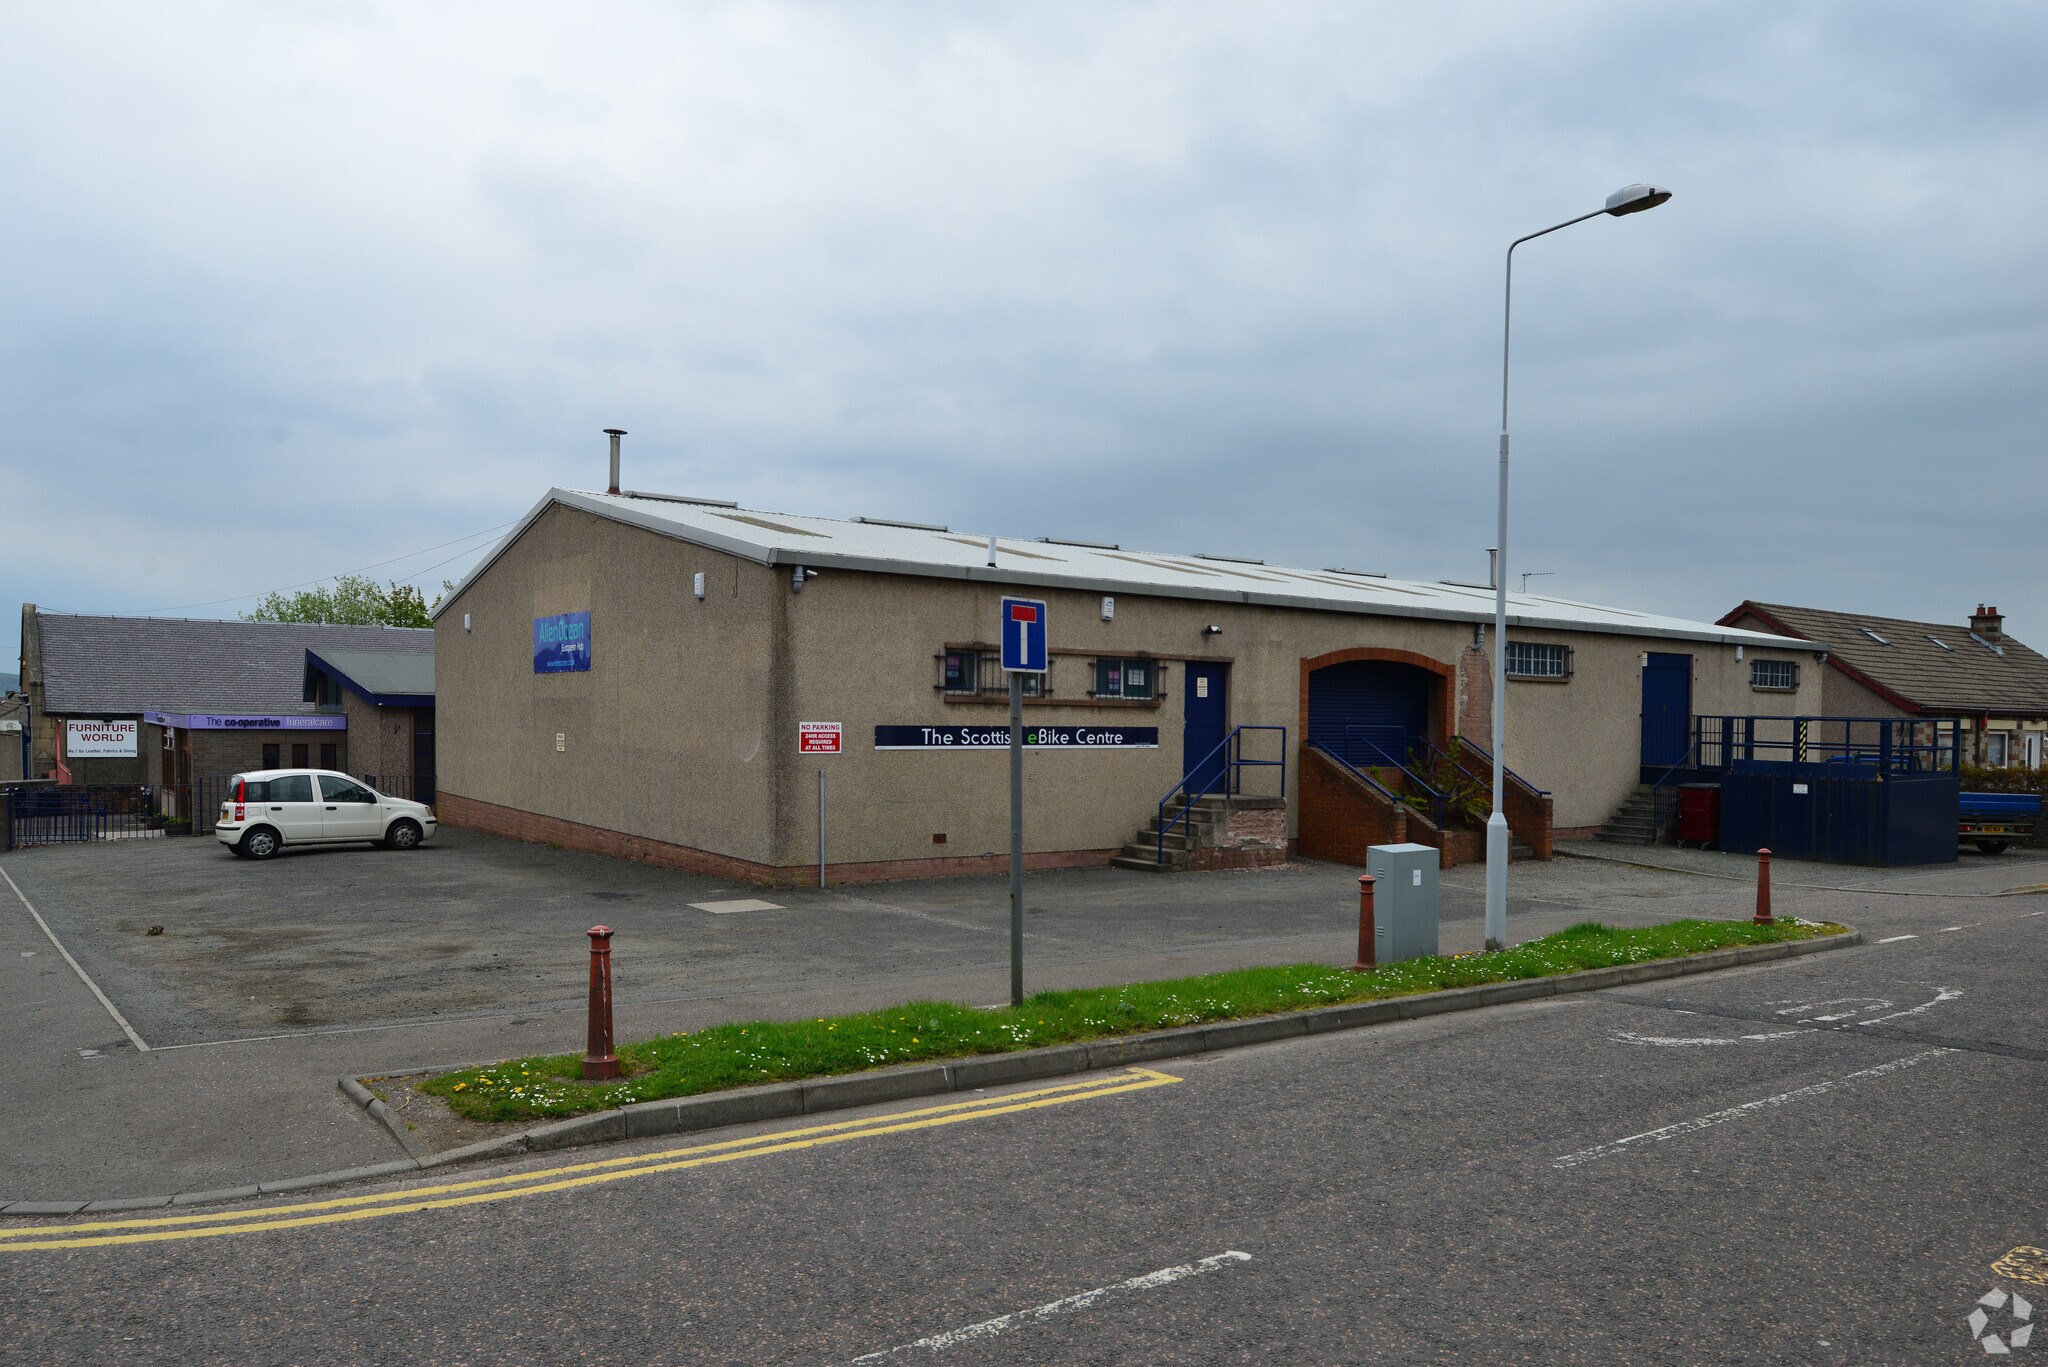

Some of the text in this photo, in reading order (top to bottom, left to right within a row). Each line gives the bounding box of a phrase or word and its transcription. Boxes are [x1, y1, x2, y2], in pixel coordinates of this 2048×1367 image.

[206, 716, 333, 727] The co-operative funeralcare
[69, 724, 135, 732] FURNITURE
[81, 733, 124, 742] WORLD
[921, 728, 1123, 744] The Scottis eBike Centre
